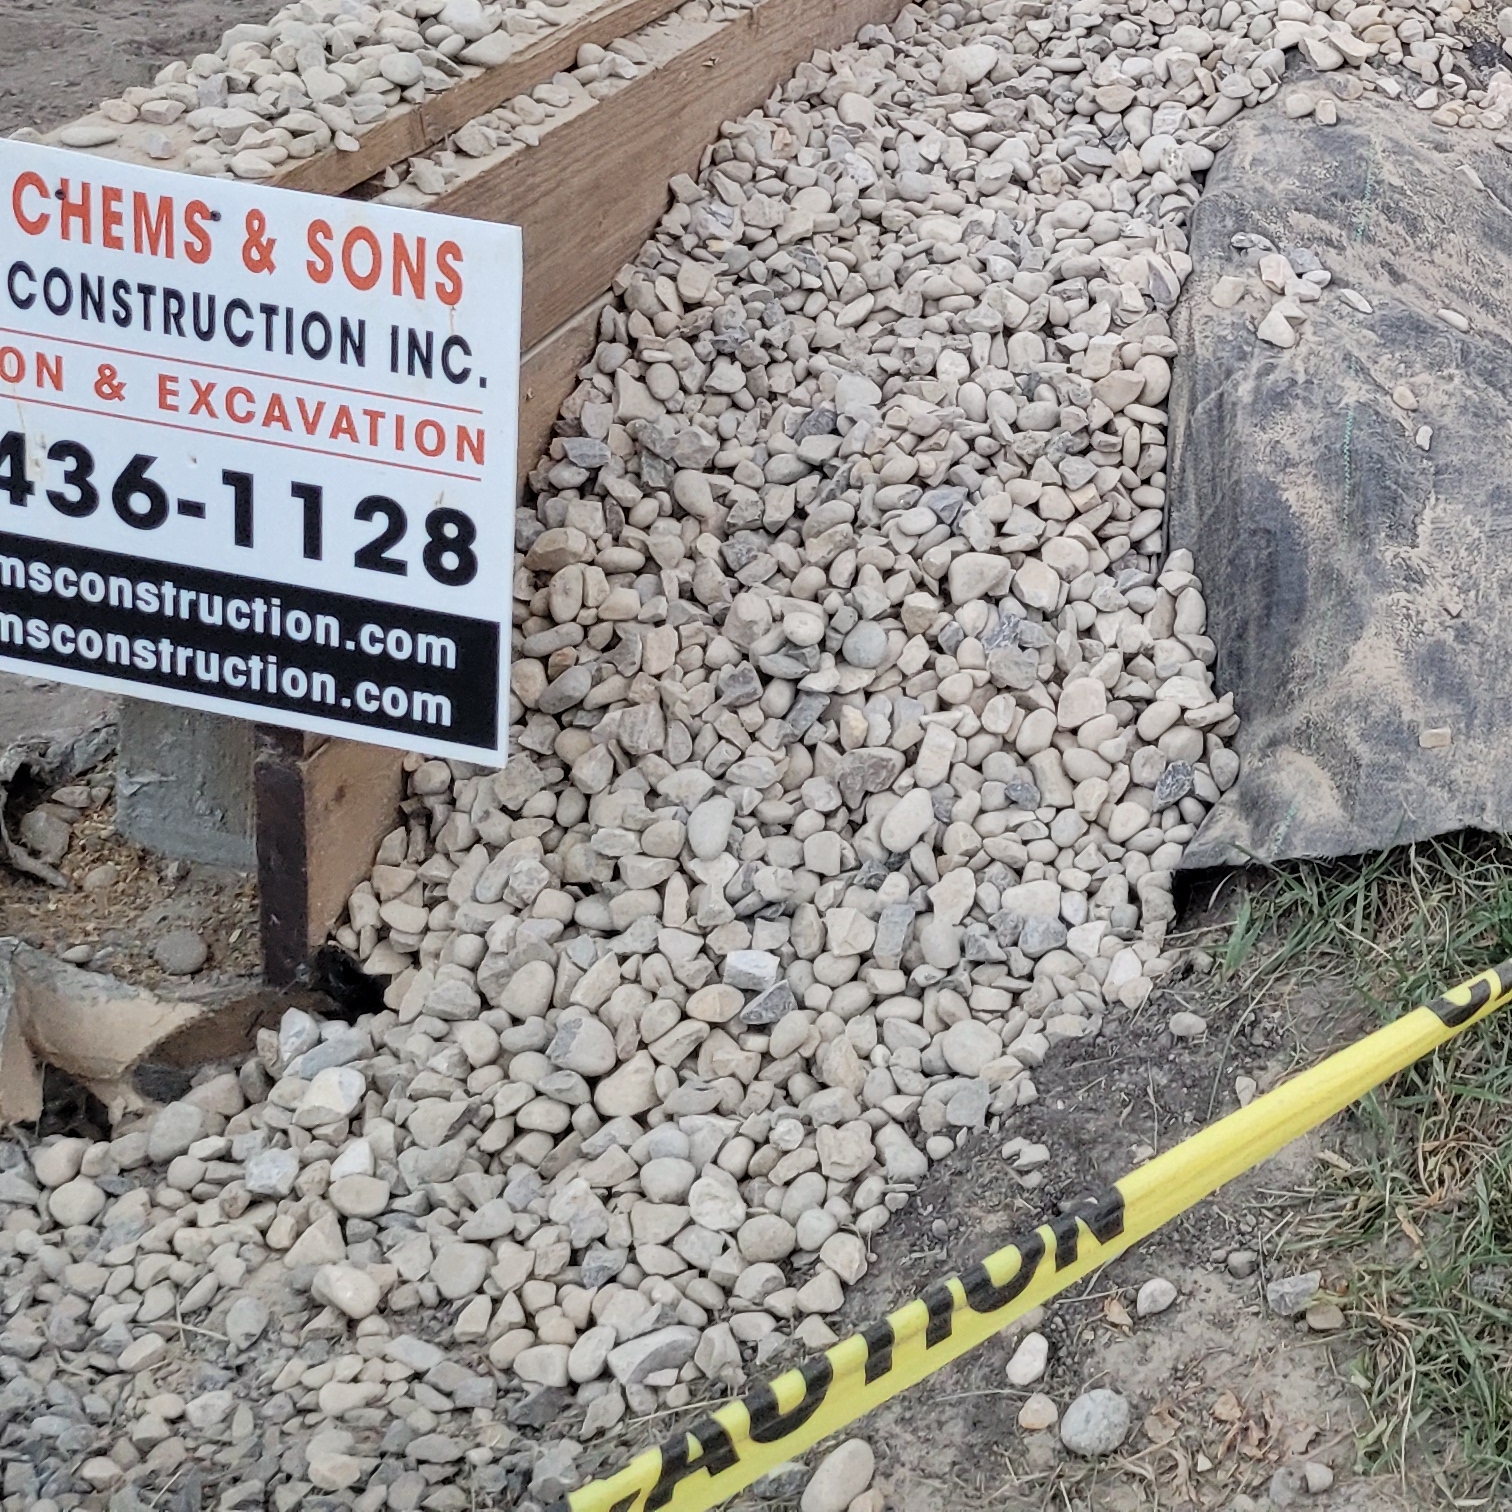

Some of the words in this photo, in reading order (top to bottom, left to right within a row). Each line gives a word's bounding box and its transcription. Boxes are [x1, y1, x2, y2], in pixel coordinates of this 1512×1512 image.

[12, 171, 213, 264] CHEMS
[242, 208, 277, 276] &
[306, 219, 465, 306] SONS
[8, 260, 367, 368] CONSTRUCTION
[390, 324, 488, 388] INC.
[0, 346, 64, 392] ON
[94, 363, 127, 402] &
[158, 374, 486, 466] EXCAVATION
[0, 430, 479, 587] 436-1128
[610, 1186, 1125, 1512] AUTION
